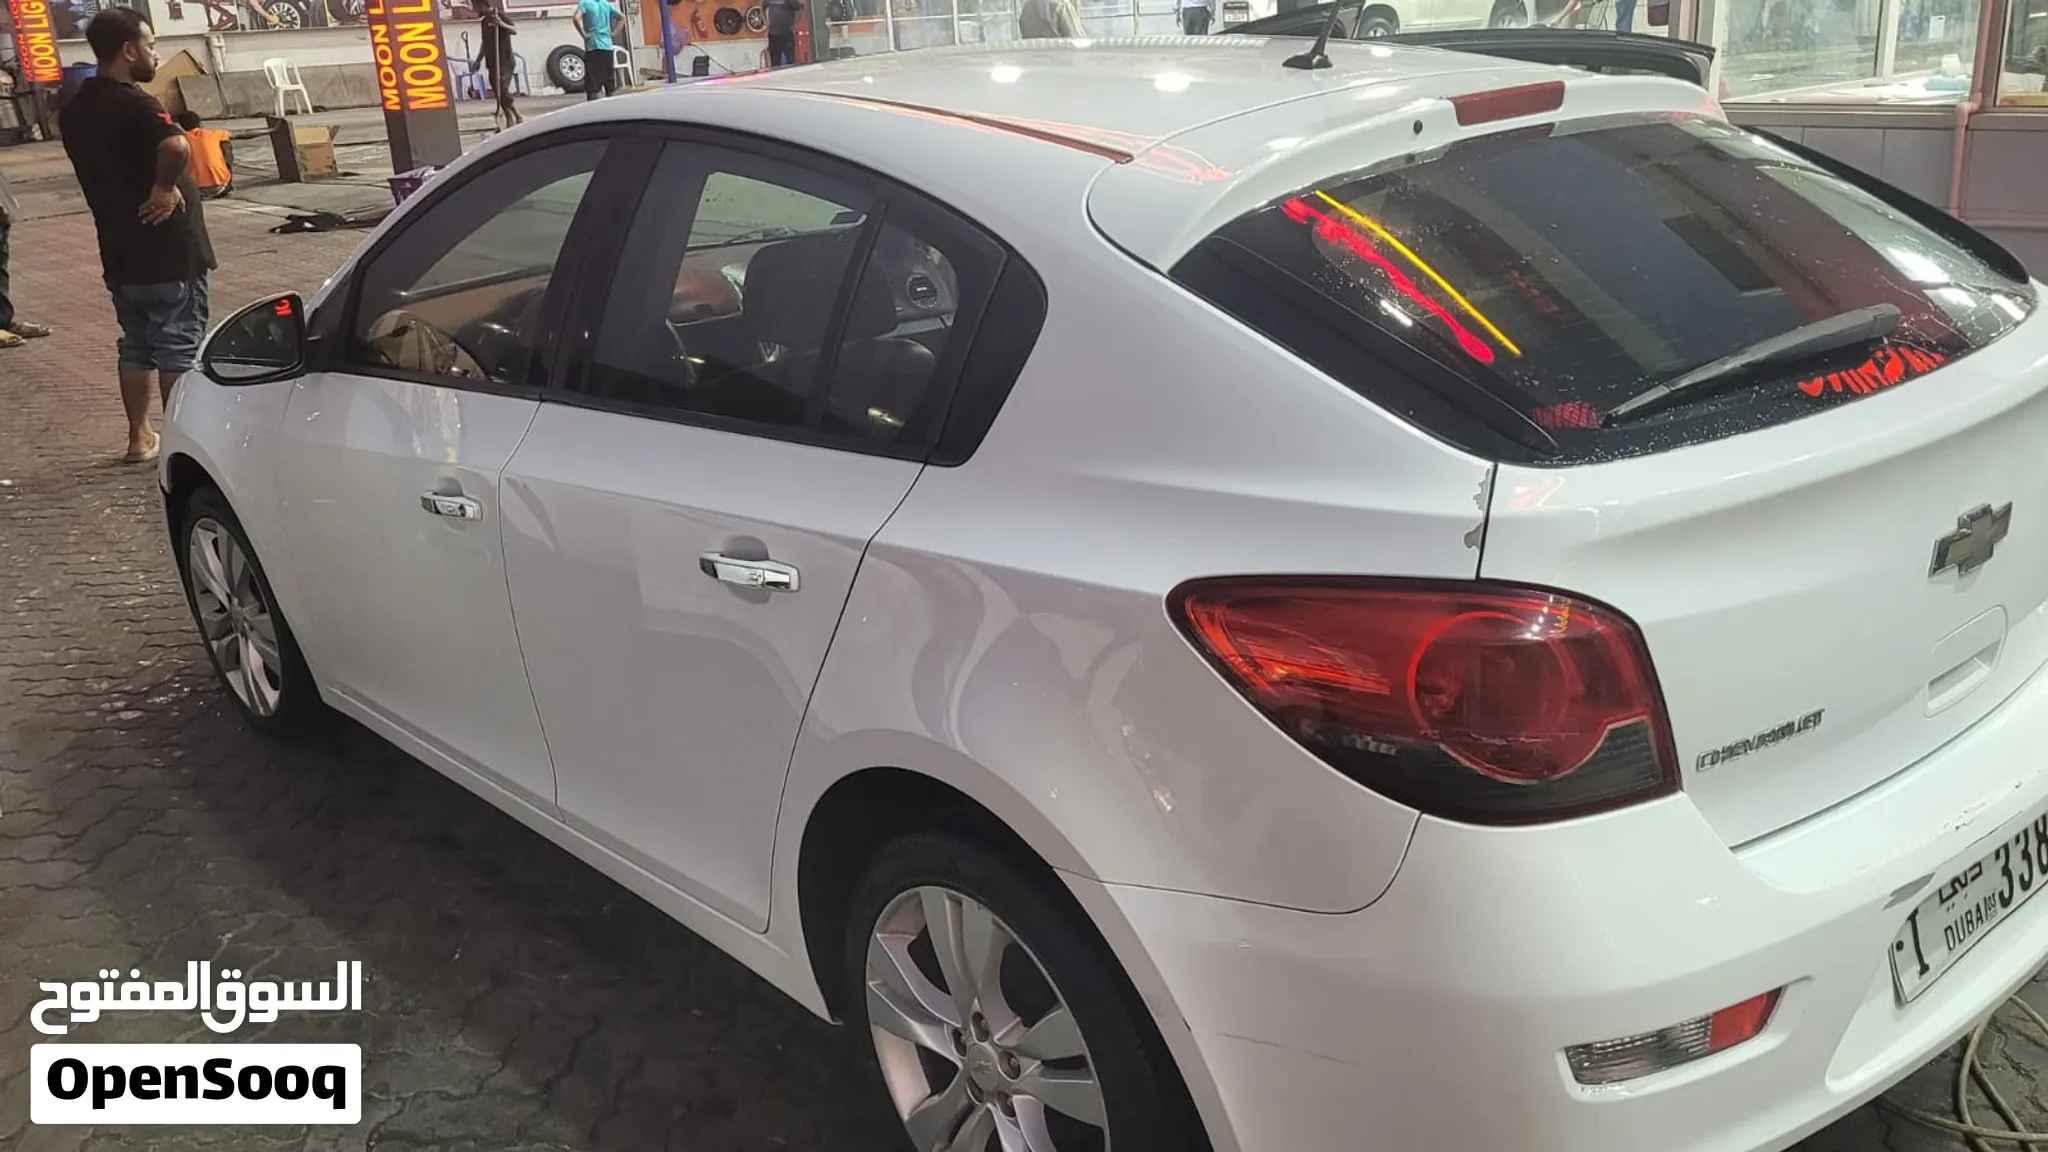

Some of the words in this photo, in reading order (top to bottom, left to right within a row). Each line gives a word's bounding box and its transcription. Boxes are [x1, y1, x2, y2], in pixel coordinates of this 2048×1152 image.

[20, 0, 49, 28] LIG
[25, 32, 62, 82] MOON
[371, 24, 401, 110] MOON
[394, 22, 449, 110] MOON
[1696, 707, 1826, 773] CHEVROLET
[1943, 895, 1989, 952] DUBAI
